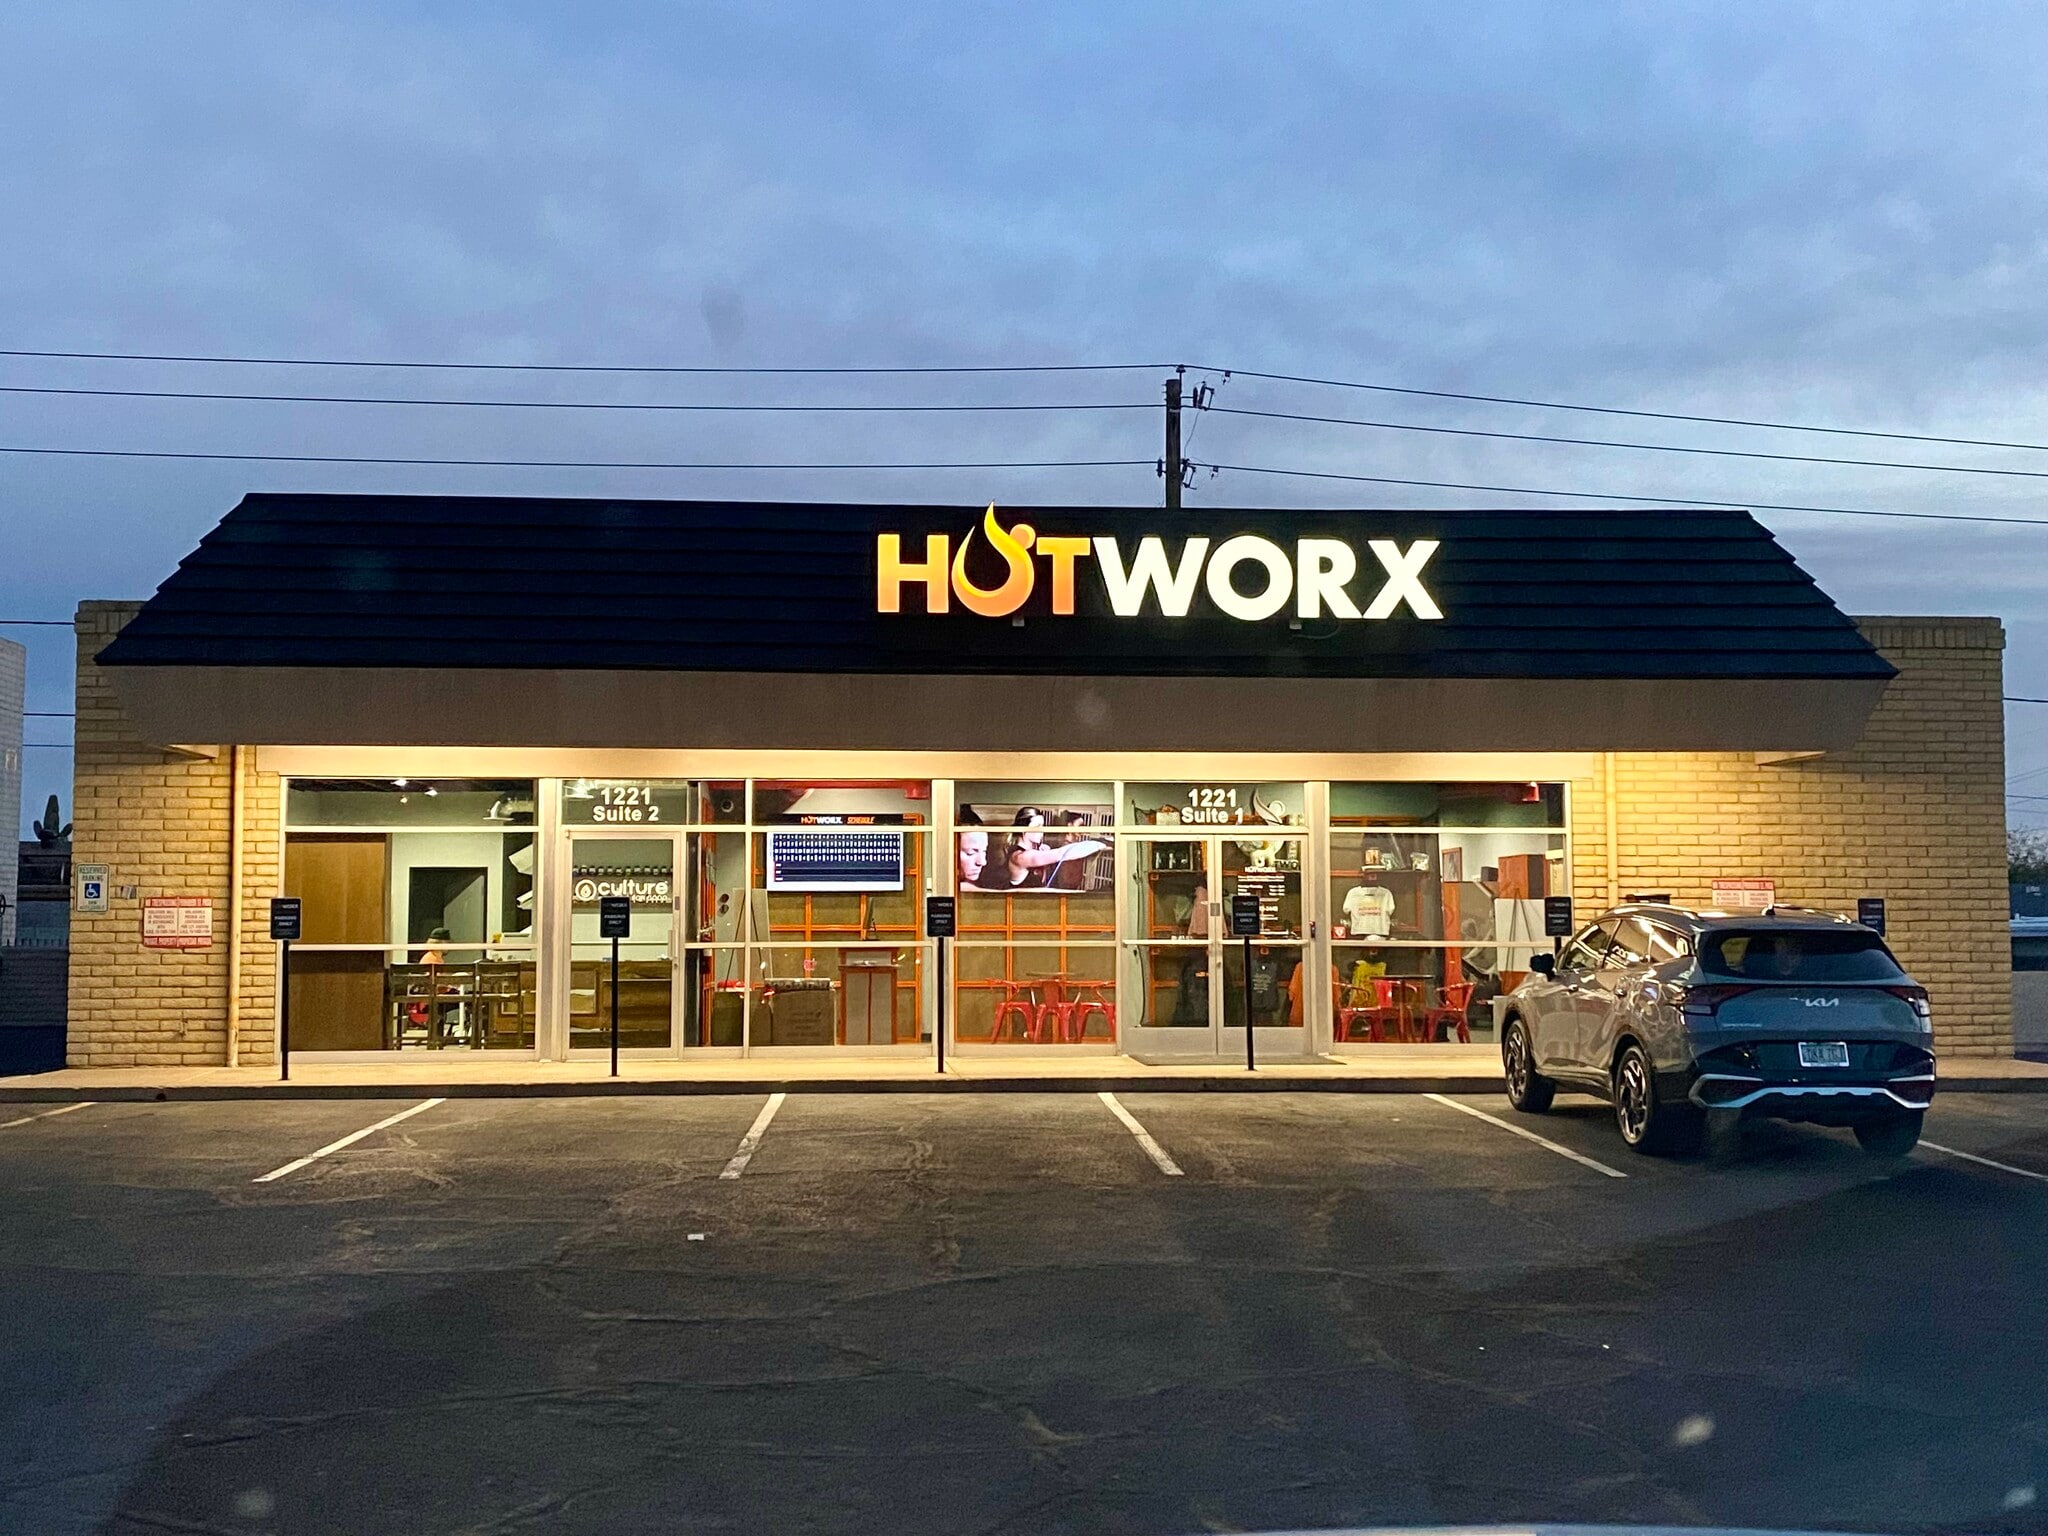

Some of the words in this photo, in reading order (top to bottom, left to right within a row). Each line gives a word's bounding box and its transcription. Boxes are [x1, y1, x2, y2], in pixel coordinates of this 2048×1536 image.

[877, 501, 1444, 621] HOTWORX
[600, 787, 651, 805] 1221
[1188, 789, 1237, 807] 1221
[592, 806, 642, 822] Suite
[648, 806, 659, 821] 2
[1181, 807, 1229, 823] Suite
[1235, 808, 1244, 823] 1
[597, 879, 668, 899] culture
[1805, 997, 1839, 1007] KIA
